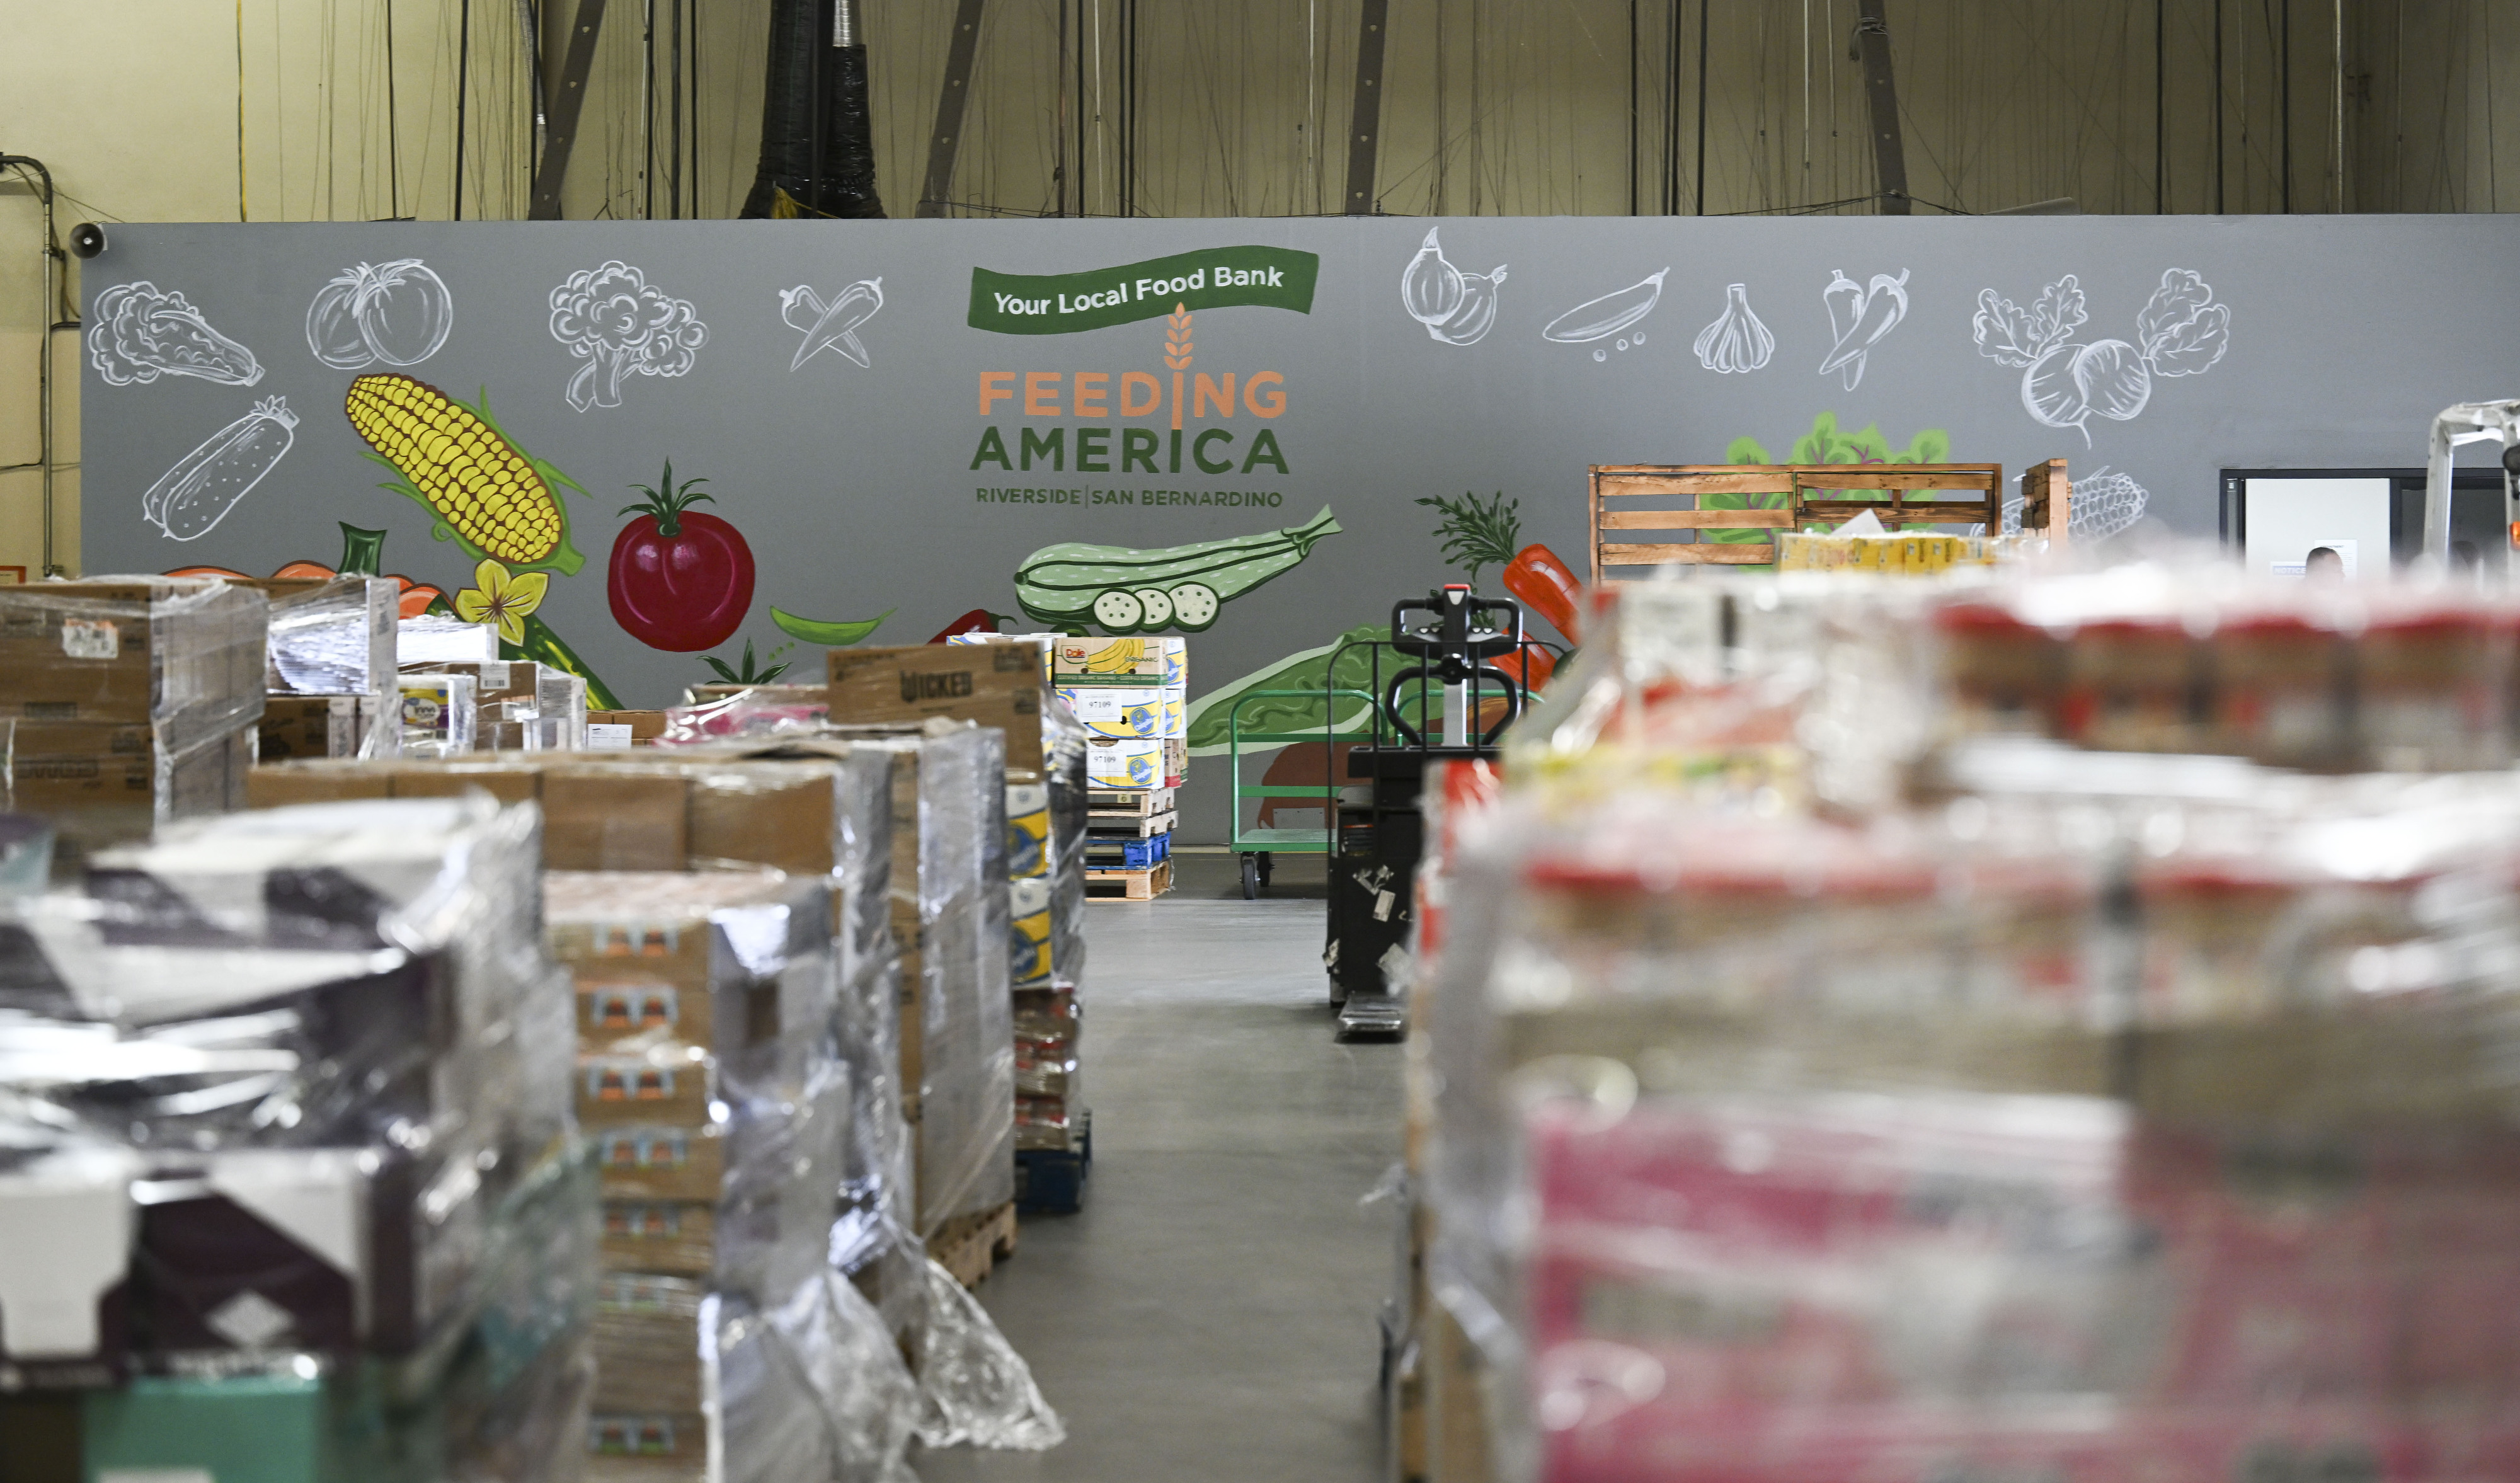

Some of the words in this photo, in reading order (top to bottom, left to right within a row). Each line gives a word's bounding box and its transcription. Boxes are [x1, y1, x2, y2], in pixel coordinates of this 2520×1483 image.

[994, 291, 1051, 315] Your
[1058, 283, 1128, 314] Local
[1136, 268, 1205, 301] Food
[1214, 266, 1285, 288] Bank
[978, 370, 1286, 429] FEEDING
[969, 426, 1290, 474] AMERICA
[976, 488, 1080, 504] RIVERSIDE
[1092, 490, 1133, 505] SAN
[1142, 491, 1283, 507] BERNARDINO
[1066, 648, 1085, 656] Dole
[900, 670, 973, 704] WICKED
